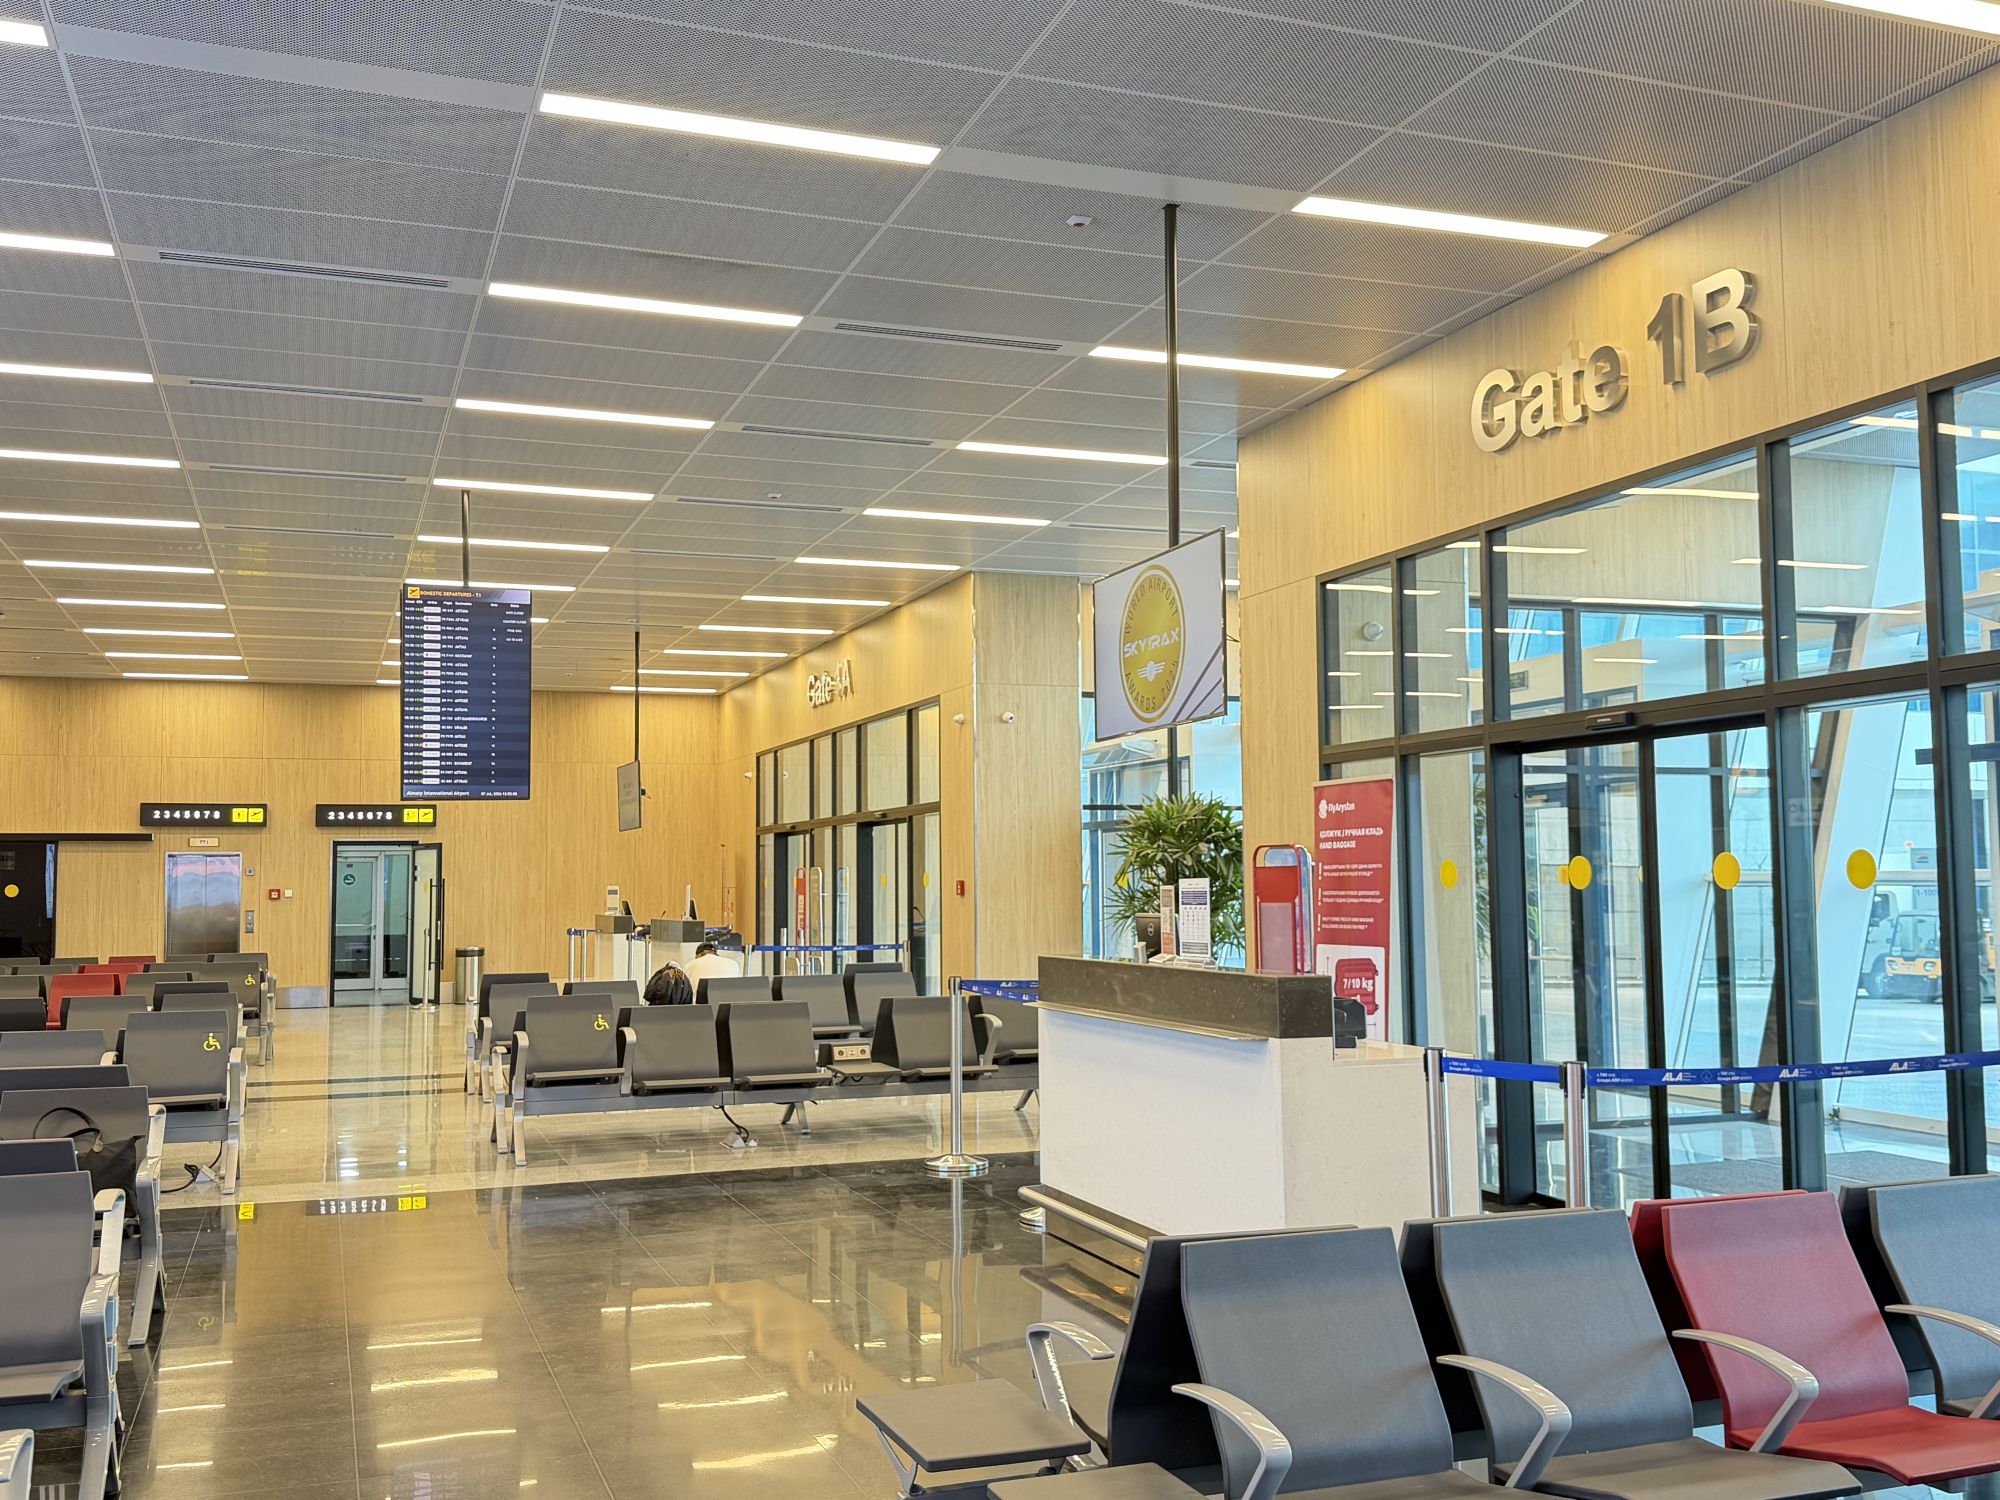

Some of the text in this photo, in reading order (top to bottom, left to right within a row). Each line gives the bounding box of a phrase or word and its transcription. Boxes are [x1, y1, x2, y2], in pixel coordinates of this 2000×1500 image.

[1471, 267, 1760, 454] Gate 1B
[1125, 577, 1179, 634] WORLD AIRPORT
[1123, 627, 1181, 658] SKYTRAX
[807, 671, 833, 708] Gate
[1124, 671, 1157, 711] AWARDS
[153, 810, 161, 819] 2
[163, 810, 170, 819] 3
[173, 810, 181, 819] 4
[183, 810, 191, 819] 5
[204, 810, 210, 819] 7
[213, 810, 221, 819] 8
[328, 811, 335, 820] 2
[338, 811, 345, 820] 3
[347, 811, 354, 820] 4
[357, 811, 364, 820] 5
[376, 811, 383, 820] 7
[385, 811, 392, 820] 8
[1328, 802, 1355, 814] FlyArystan
[1333, 840, 1356, 849] BAGGAGE
[1343, 977, 1374, 991] 7/10 kg
